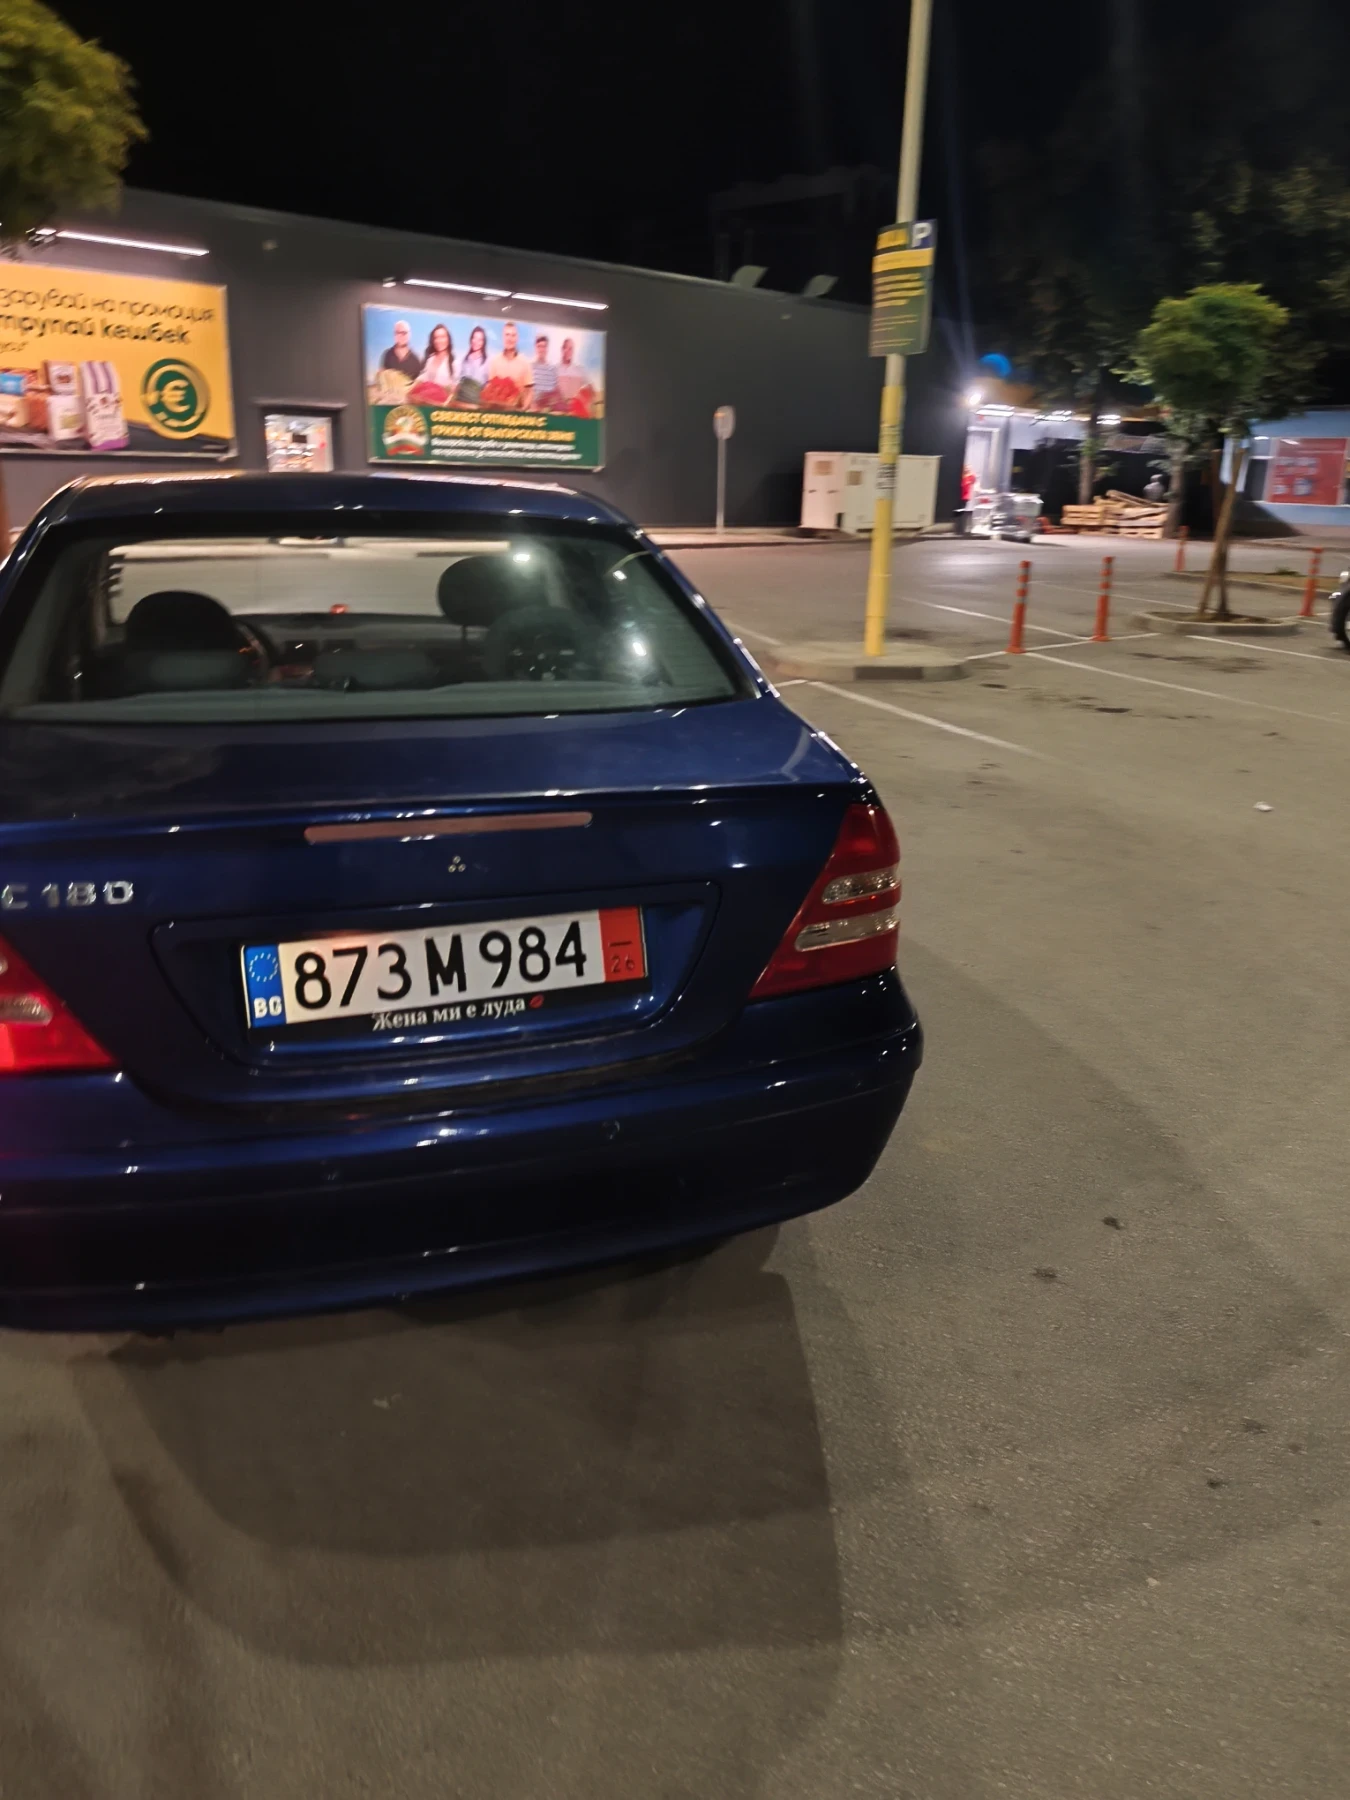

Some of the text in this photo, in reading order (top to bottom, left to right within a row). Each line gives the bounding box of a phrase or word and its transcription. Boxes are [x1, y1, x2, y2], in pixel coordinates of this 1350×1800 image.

[911, 222, 932, 248] P
[101, 318, 191, 345] кешбек
[1, 880, 134, 909] C 180
[294, 942, 412, 1010] 873
[478, 920, 587, 989] 984
[610, 953, 636, 974] 26
[253, 995, 282, 1019] BG
[371, 998, 526, 1031] Жена ми е луда
